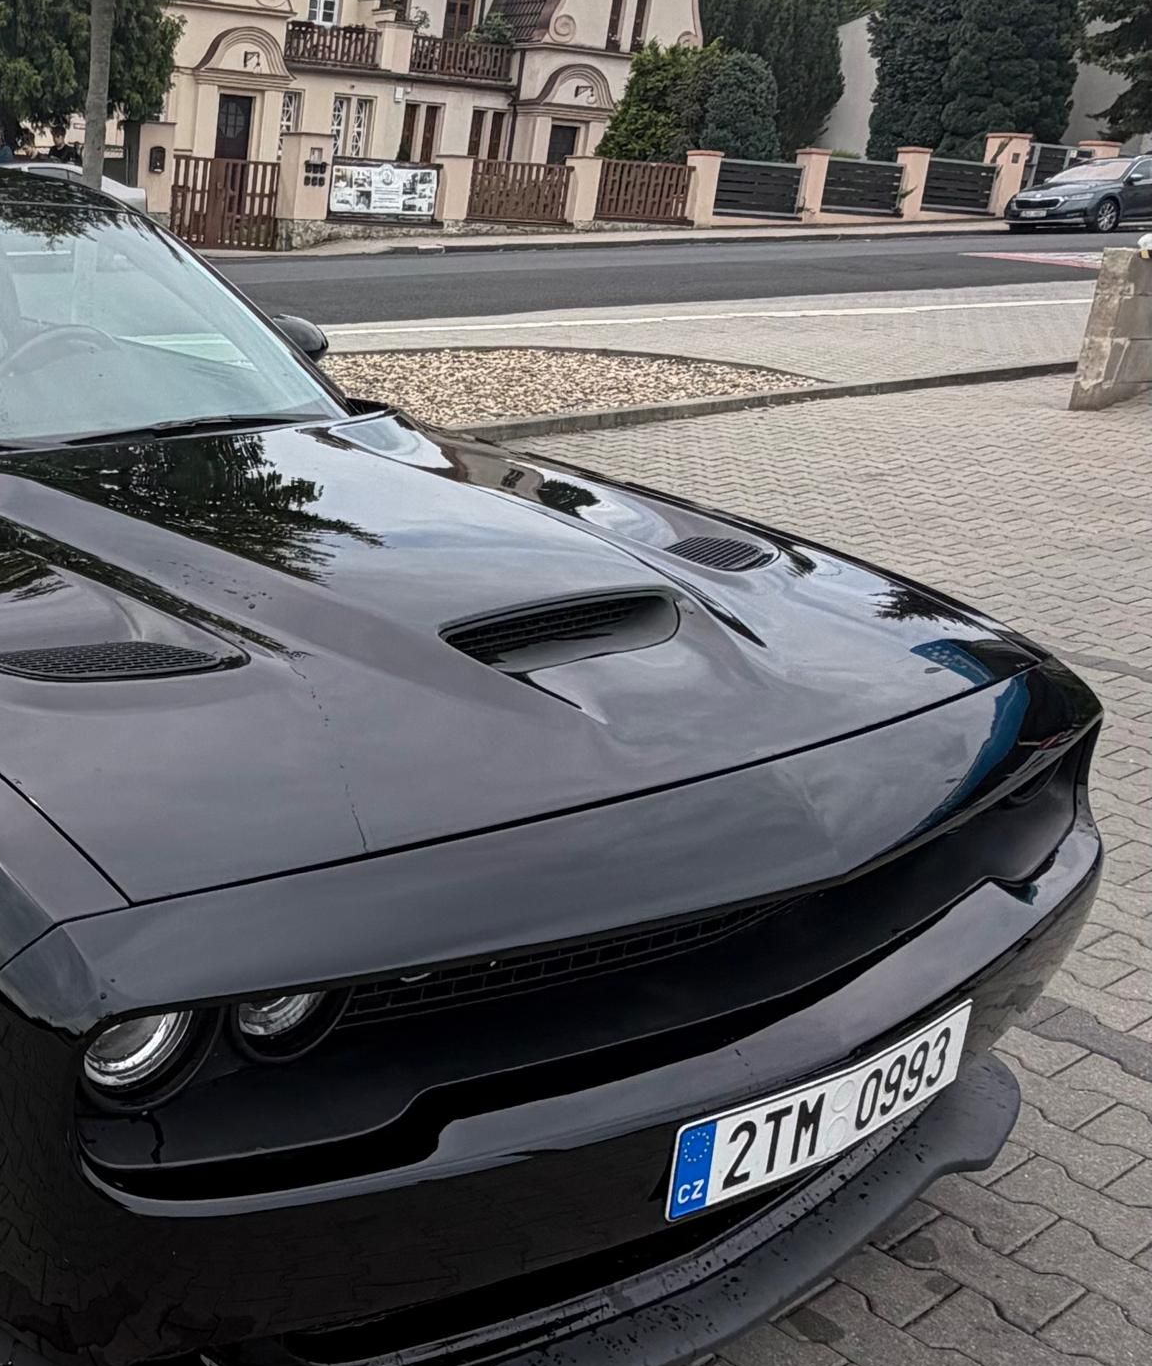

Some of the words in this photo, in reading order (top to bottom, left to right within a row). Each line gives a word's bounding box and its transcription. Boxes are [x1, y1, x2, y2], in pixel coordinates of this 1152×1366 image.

[721, 1092, 825, 1191] 2TM
[854, 1026, 952, 1131] 0993
[676, 1178, 704, 1205] CZ
